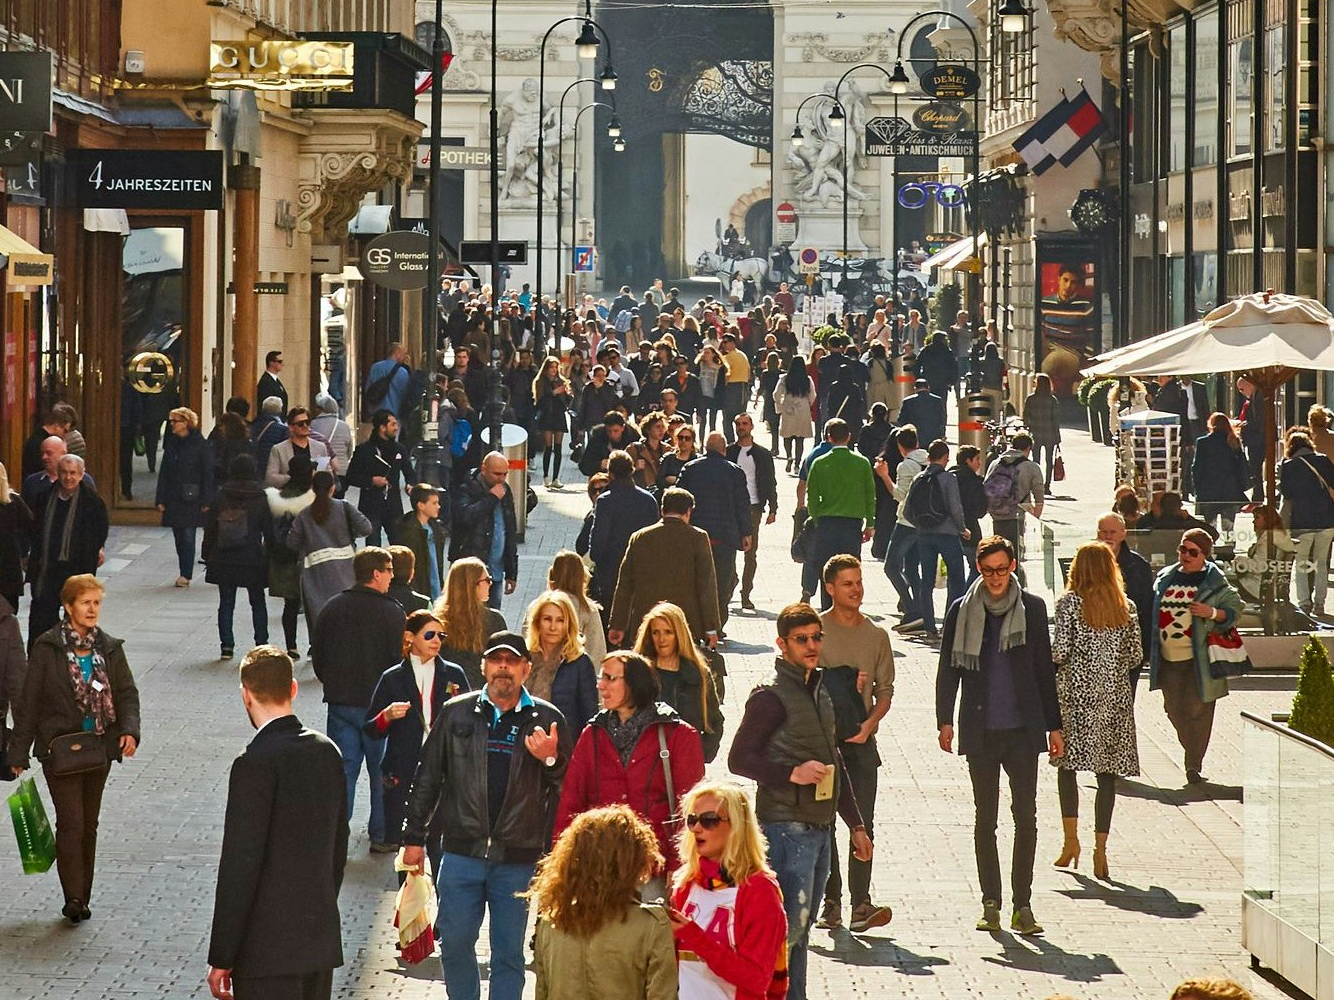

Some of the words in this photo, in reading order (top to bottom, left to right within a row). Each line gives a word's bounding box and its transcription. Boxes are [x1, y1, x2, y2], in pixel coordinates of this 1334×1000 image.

[217, 46, 347, 69] GUCCI
[933, 76, 968, 85] DEMEL
[923, 110, 963, 123] Chopard
[88, 160, 103, 190] 4
[106, 179, 212, 192] JAHRESZEITEN
[367, 248, 391, 265] GS
[399, 261, 424, 271] Glass
[1223, 559, 1293, 574] NORDSEE
